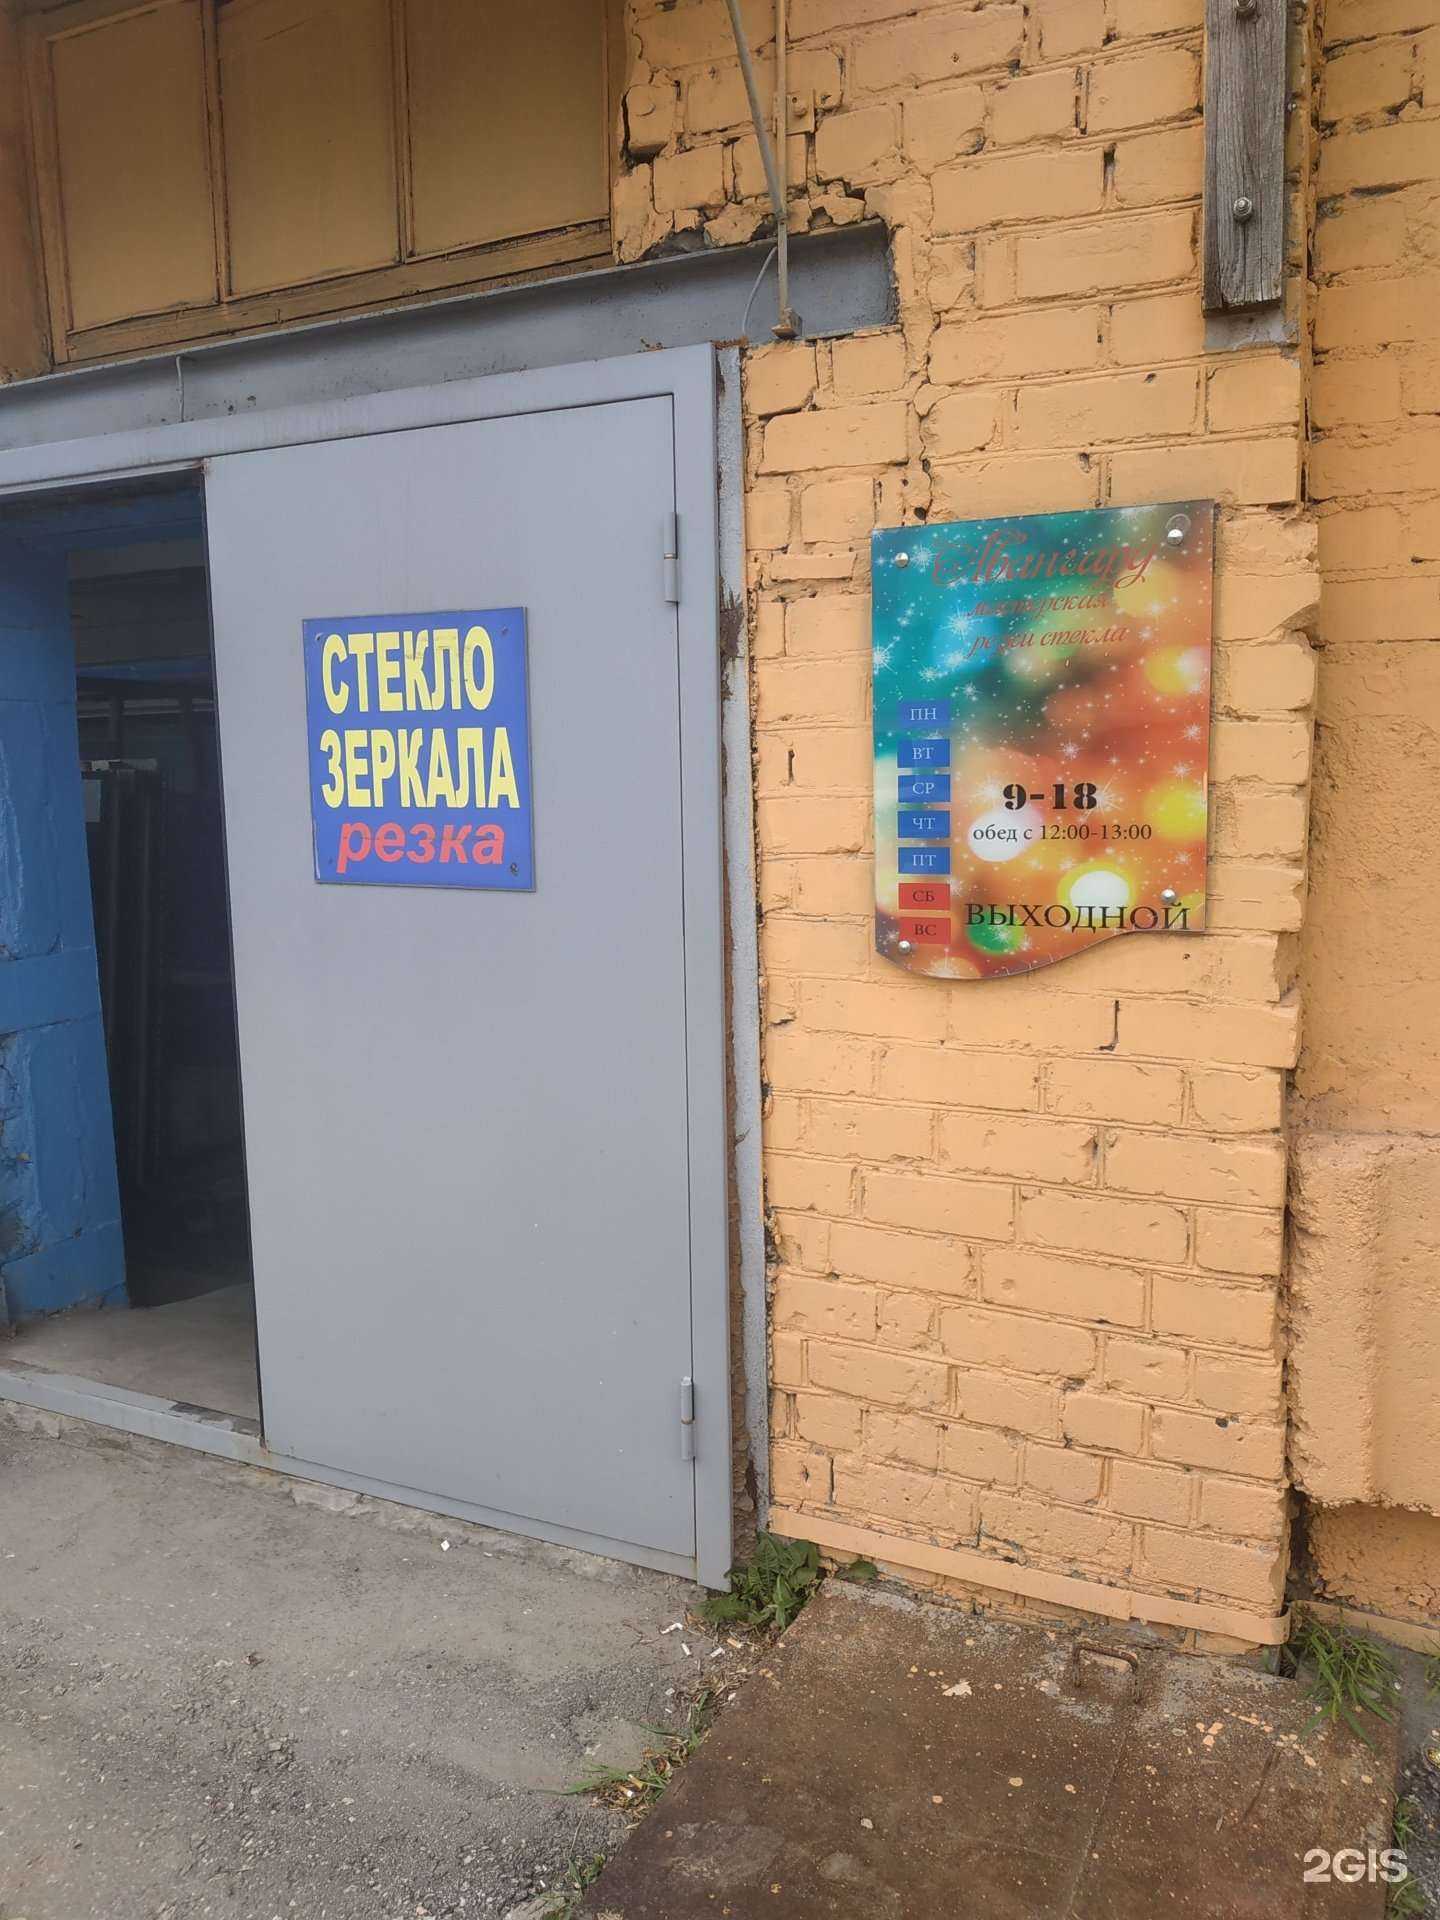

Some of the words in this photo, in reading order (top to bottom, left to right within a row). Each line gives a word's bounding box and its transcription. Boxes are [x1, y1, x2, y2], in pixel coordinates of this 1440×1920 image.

[1040, 623, 1130, 646] стекла
[321, 625, 495, 714] СТЕКЛО
[910, 707, 938, 722] ПН
[912, 747, 935, 762] ВТ
[319, 726, 520, 809] ЗЕРКАЛА
[912, 782, 936, 797] СР
[1002, 782, 1099, 812] 9-18
[912, 817, 937, 831] ЧТ
[972, 824, 1019, 843] обед
[1023, 829, 1033, 841] с
[1039, 824, 1153, 841] 12:00-13:00
[336, 822, 505, 874] резка
[912, 853, 938, 868] ПТ
[912, 889, 936, 904] СБ
[965, 902, 1191, 933] ВЫХОДНОЙ
[913, 923, 938, 938] ВС
